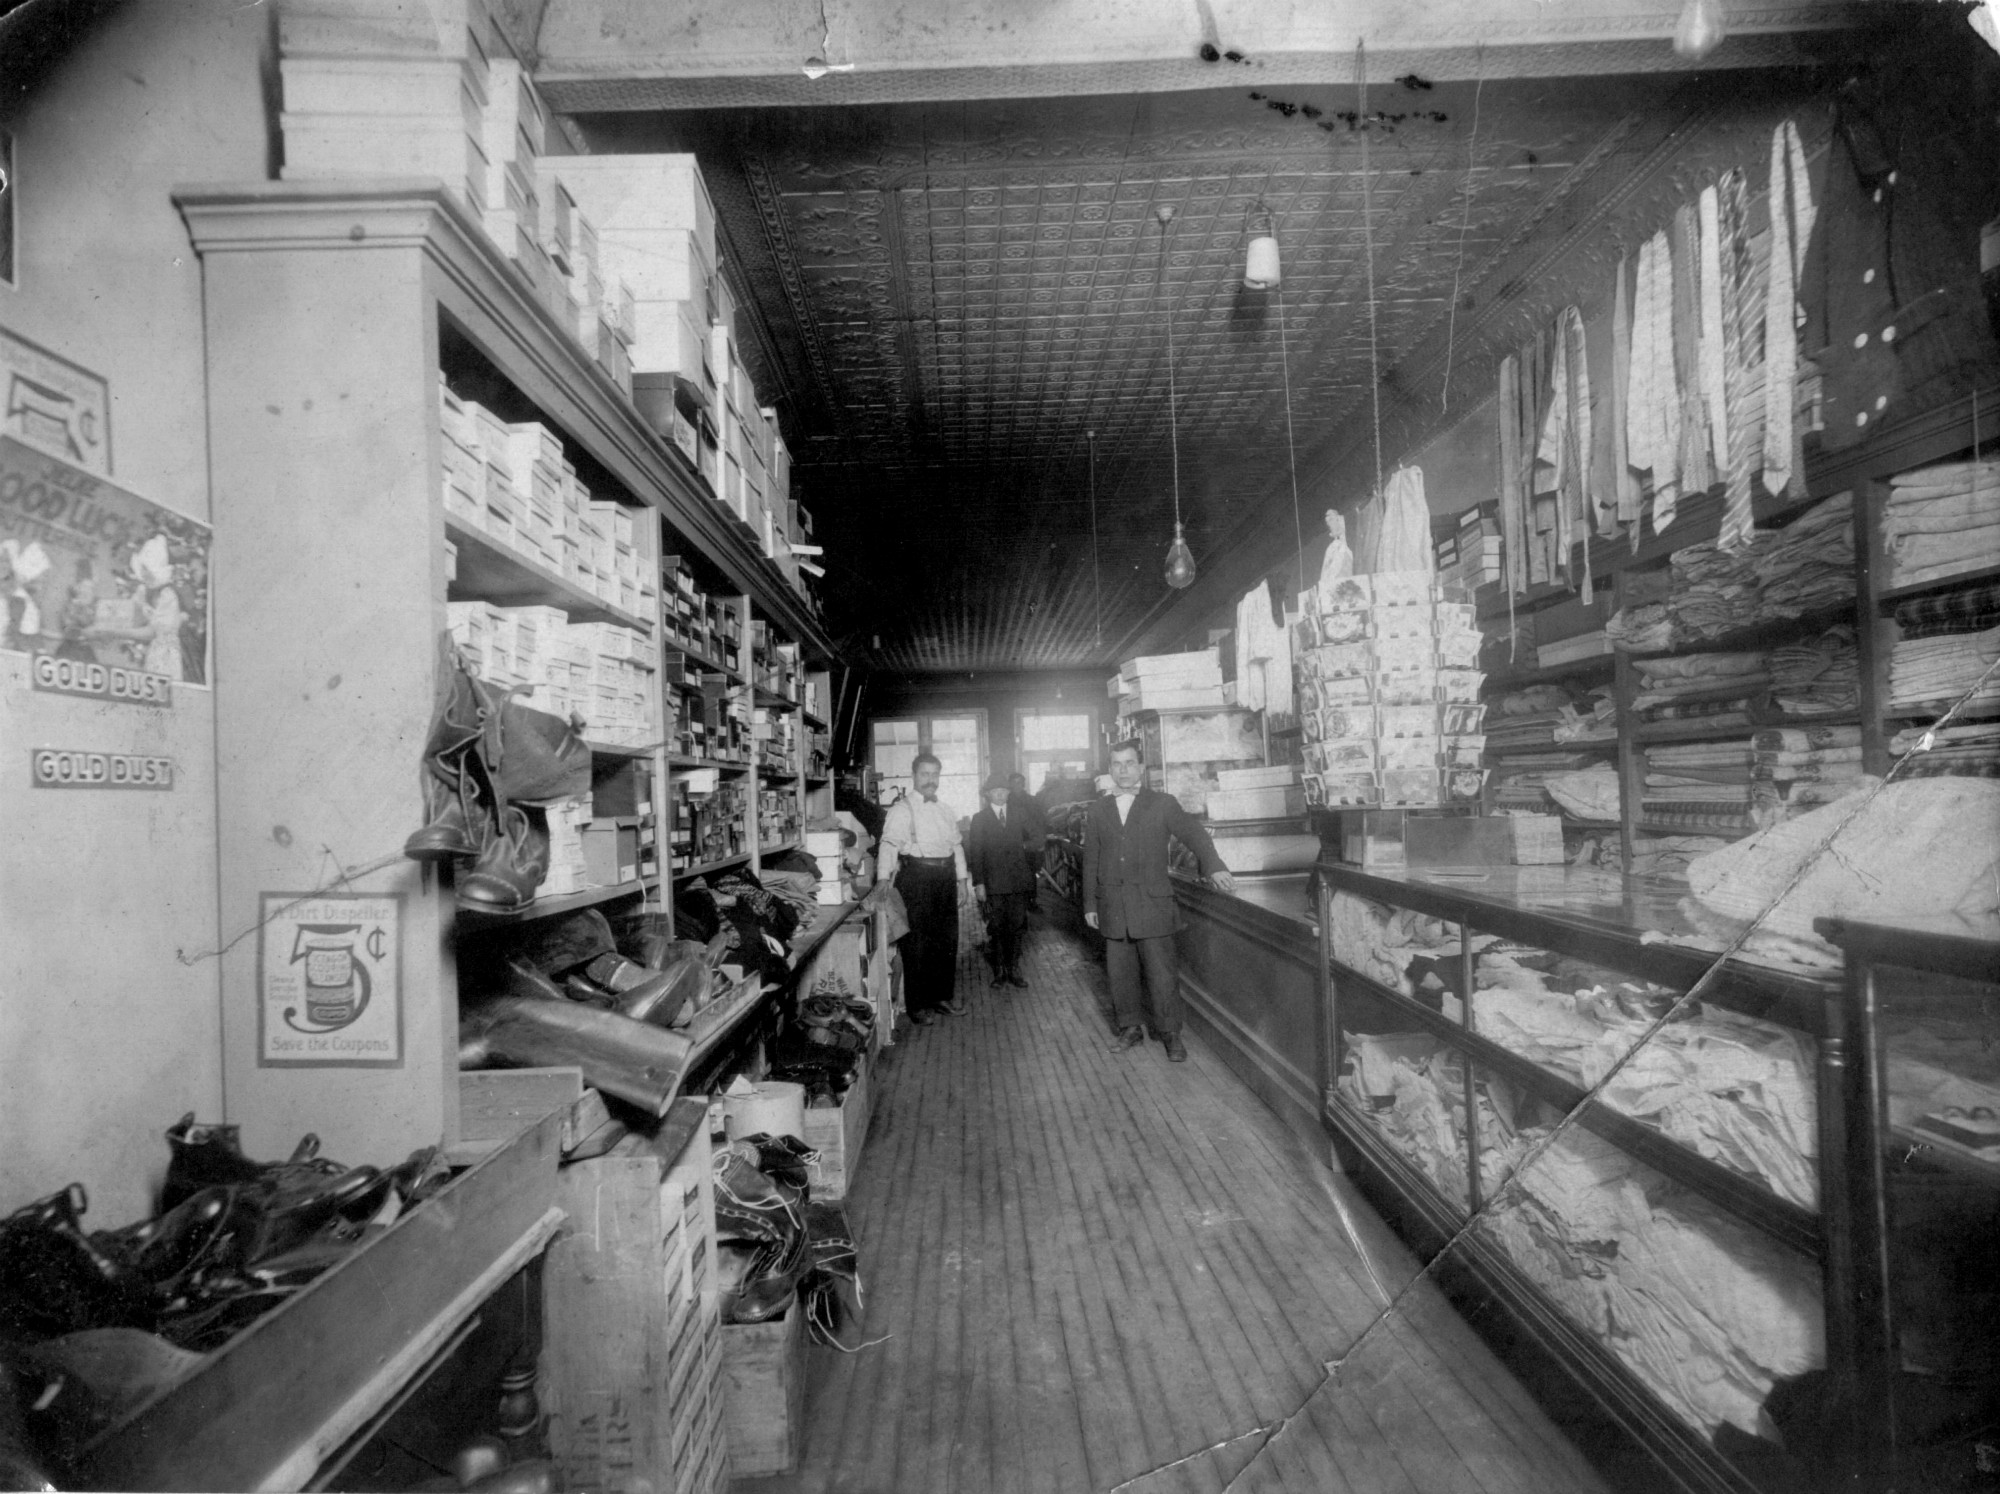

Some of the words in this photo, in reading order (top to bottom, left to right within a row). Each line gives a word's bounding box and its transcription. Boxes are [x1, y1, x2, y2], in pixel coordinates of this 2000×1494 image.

[0, 462, 67, 519] OOD
[34, 655, 109, 694] GOLD
[110, 667, 172, 703] DUST
[35, 751, 109, 783] GOLD
[110, 755, 172, 785] DUST
[271, 1036, 304, 1052] Save
[308, 1036, 329, 1052] the
[332, 1036, 390, 1057] Coupons
